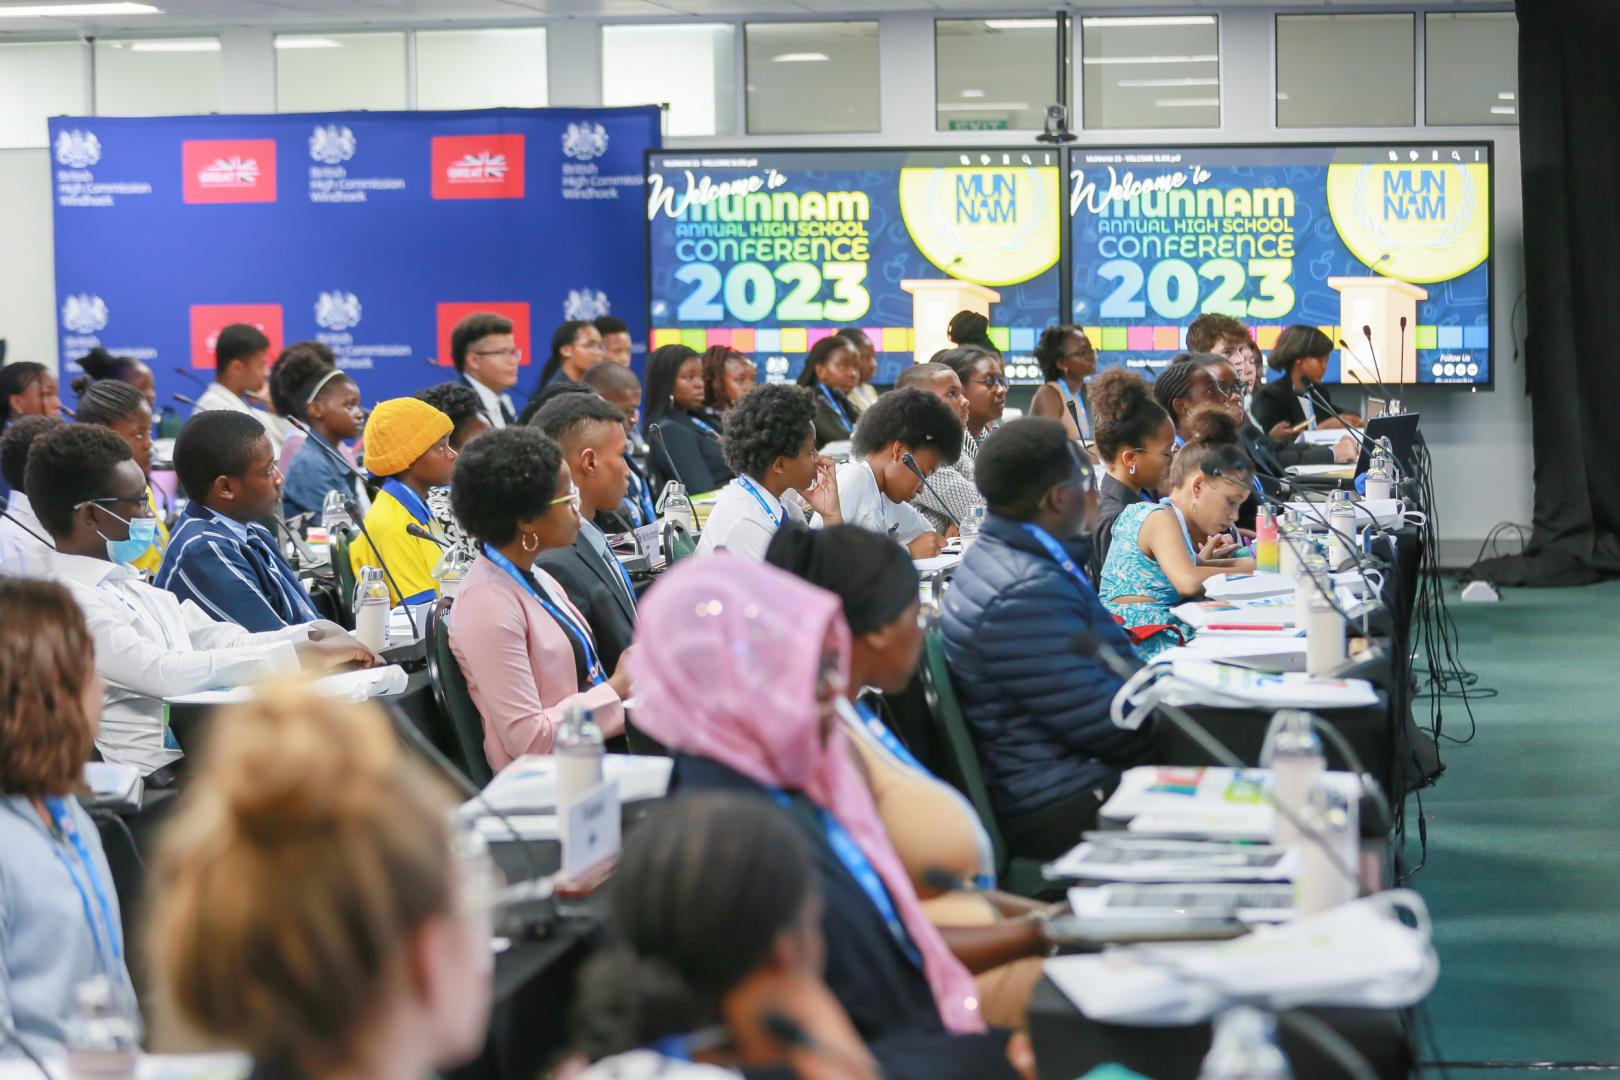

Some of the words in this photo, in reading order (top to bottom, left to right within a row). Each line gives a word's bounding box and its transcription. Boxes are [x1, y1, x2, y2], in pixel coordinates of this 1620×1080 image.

[1070, 165, 1187, 216] Welcome
[750, 222, 795, 237] HIGH
[797, 221, 869, 237] SCHOOL
[1174, 218, 1219, 233] HIGH
[1222, 217, 1294, 233] SCHOOL
[674, 261, 871, 323] 2023
[1097, 258, 1296, 320] 2023
